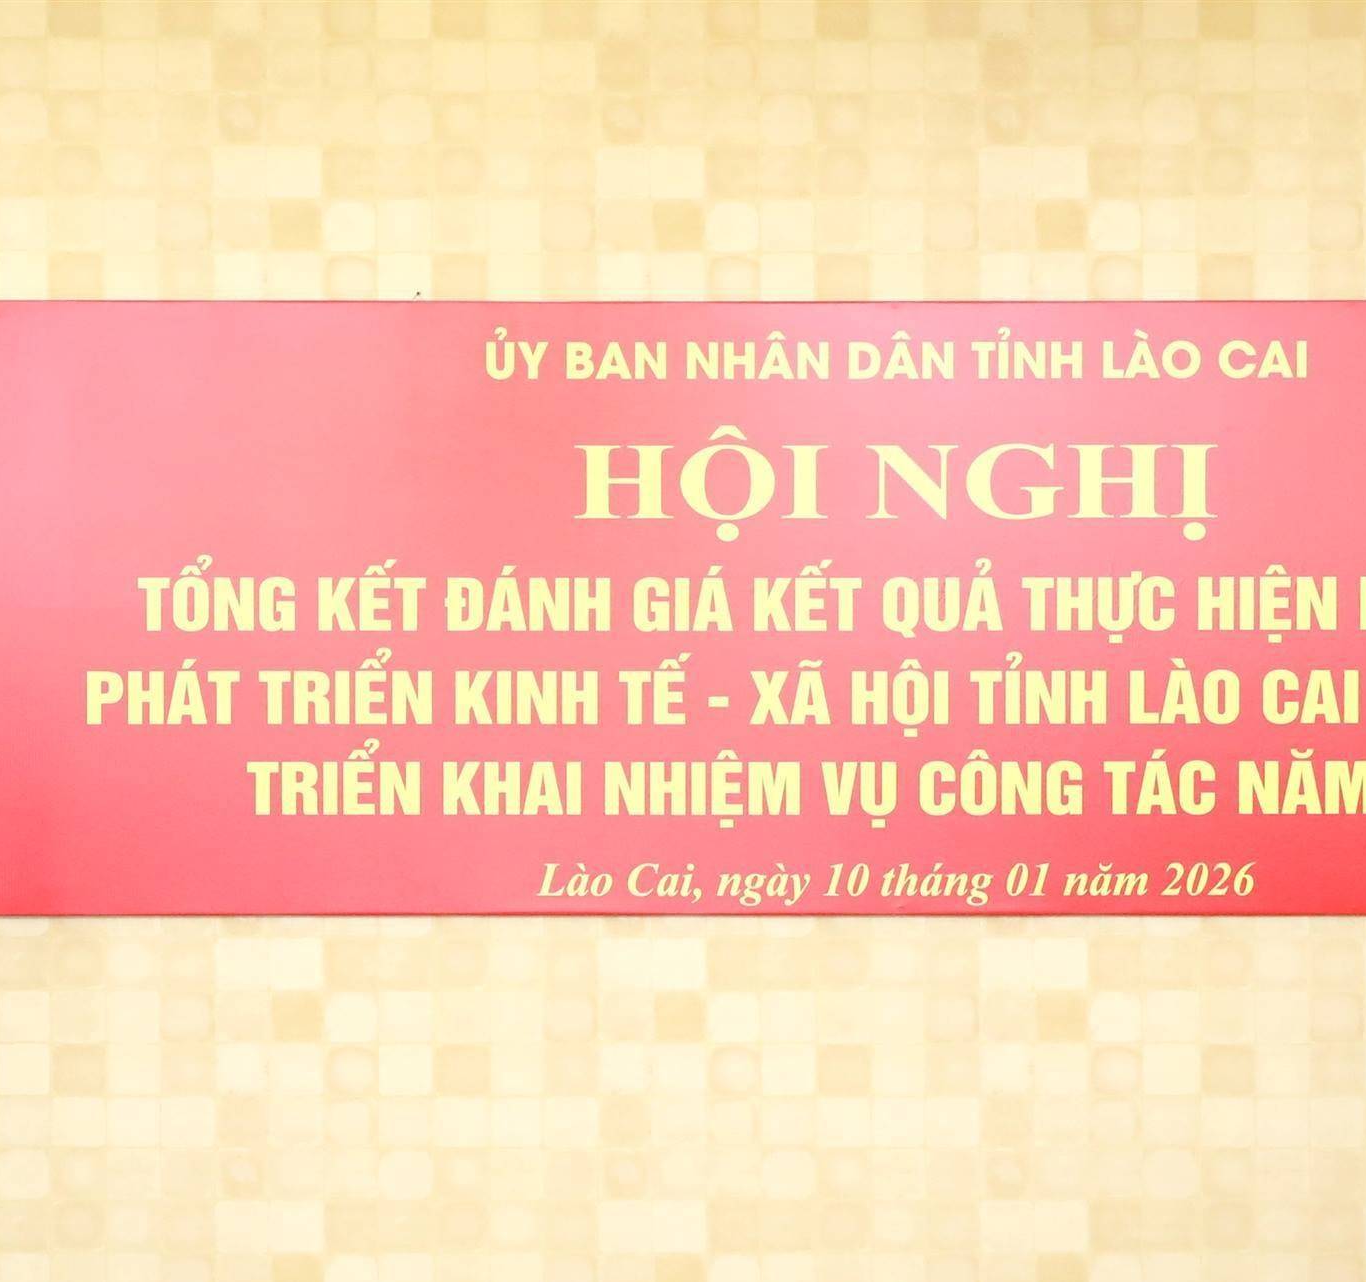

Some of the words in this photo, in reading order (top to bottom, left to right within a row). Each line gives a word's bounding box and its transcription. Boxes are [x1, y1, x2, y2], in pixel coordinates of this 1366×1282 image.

[484, 325, 549, 381] ỦY
[564, 340, 668, 381] BAN
[686, 331, 831, 380] NHÂN
[848, 331, 955, 379] DÂN
[971, 328, 1083, 379] TỈNH
[1103, 330, 1201, 379] LÀO
[1219, 340, 1308, 379] CAI
[575, 425, 827, 542] HỘI
[870, 443, 1214, 540] NGHỊ
[138, 554, 296, 632] TỔNG
[318, 559, 427, 632] KẾT
[444, 564, 613, 632] ĐÁNH
[631, 564, 735, 632] GIÁ
[753, 560, 864, 632] KẾT
[882, 558, 1003, 637] QUẢ
[1022, 570, 1176, 644] THỰC
[1197, 564, 1339, 644] HIỆN
[85, 658, 241, 726] PHÁT
[258, 647, 434, 726] TRIỂN
[453, 668, 600, 726] KINH
[618, 652, 691, 725] TẾ
[708, 695, 730, 709] -
[751, 659, 832, 726] XÃ
[851, 659, 950, 735] HỘI
[970, 651, 1109, 725] TỈNH
[1128, 657, 1242, 725] LÀO
[1262, 668, 1361, 725] CAI
[246, 738, 422, 816] TRIỂN
[442, 760, 583, 816] KHAI
[603, 748, 802, 829] NHIỆM
[821, 761, 899, 829] VỤ
[918, 748, 1084, 816] CÔNG
[1102, 748, 1217, 816] TÁC
[540, 864, 613, 896] Lào
[627, 864, 703, 901] Cai,
[718, 864, 811, 905] ngày
[827, 864, 870, 896] 10
[880, 864, 993, 905] tháng
[1006, 864, 1050, 896] 01
[1062, 864, 1151, 896] năm
[1161, 861, 1255, 896] 2026
